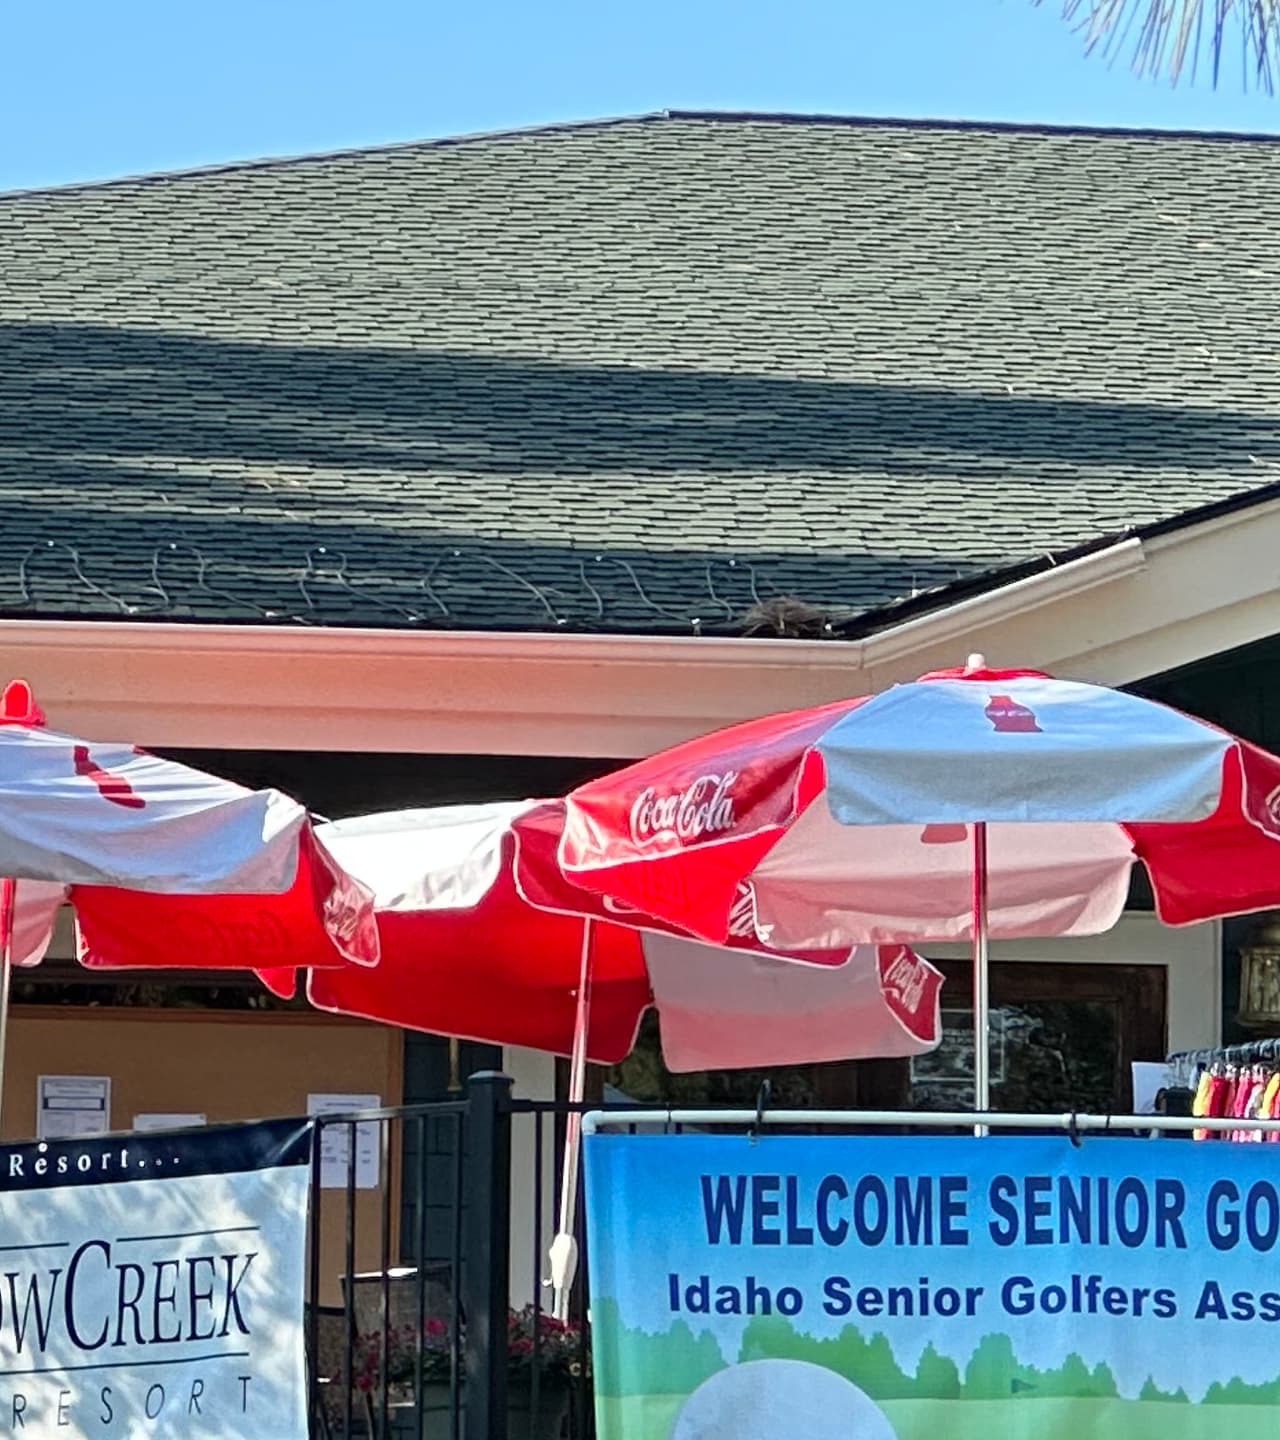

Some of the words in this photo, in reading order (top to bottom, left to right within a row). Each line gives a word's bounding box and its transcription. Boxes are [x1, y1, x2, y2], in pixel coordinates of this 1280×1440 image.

[700, 1173, 970, 1247] WELCOME
[987, 1174, 1188, 1249] SENIOR
[668, 1273, 804, 1316] Idaho
[822, 1275, 984, 1317] Senior
[1001, 1274, 1178, 1319] Golfers
[12, 1376, 253, 1430] RESORT
